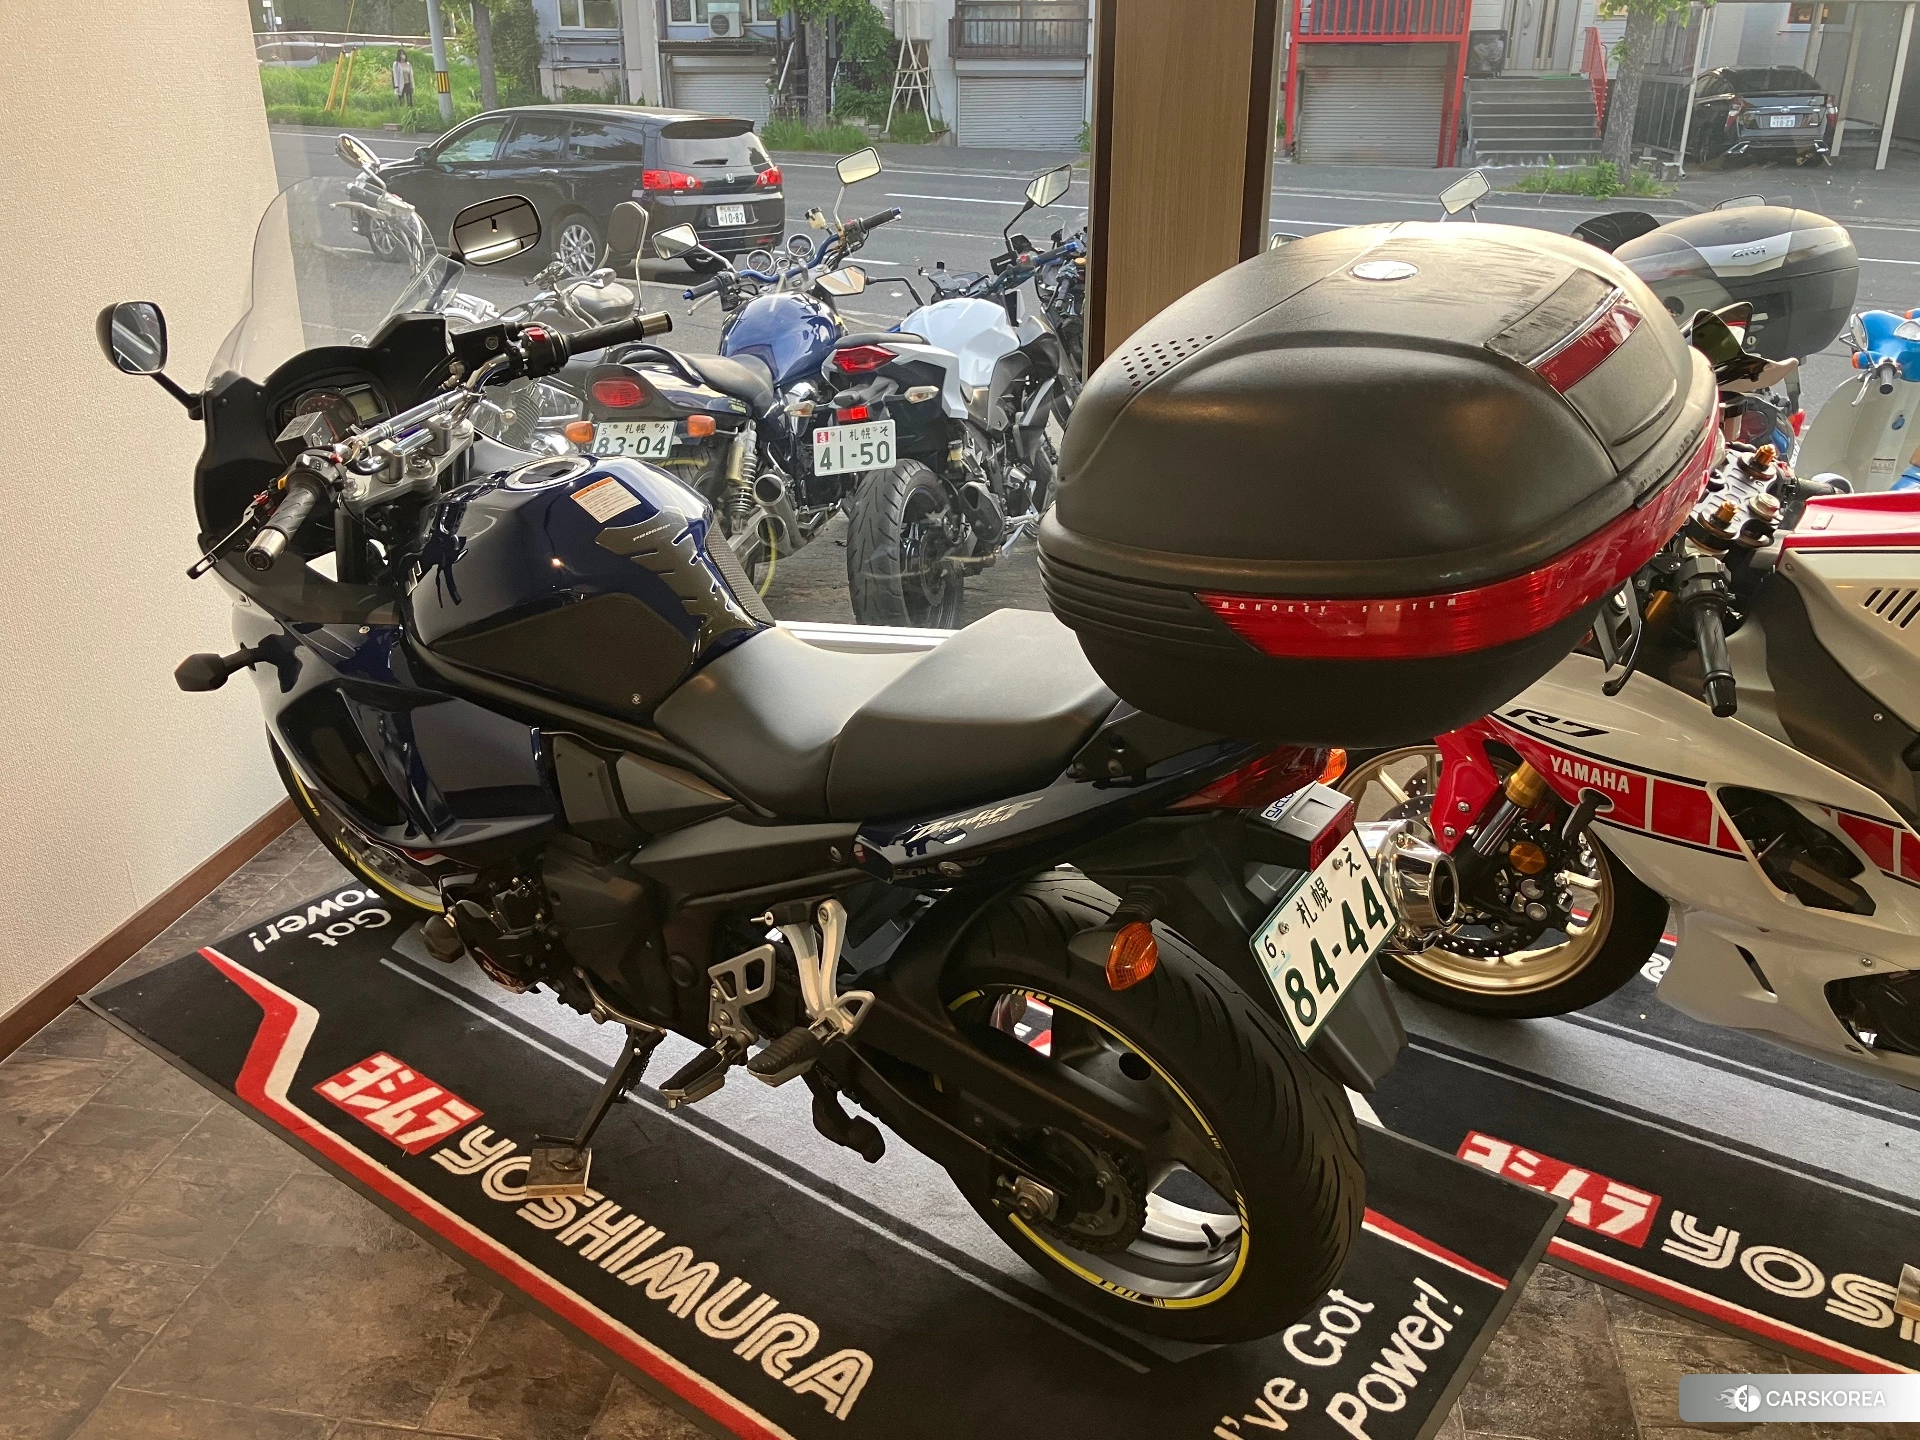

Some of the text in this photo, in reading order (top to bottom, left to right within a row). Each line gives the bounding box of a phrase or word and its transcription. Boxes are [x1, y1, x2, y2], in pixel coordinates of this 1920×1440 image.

[724, 212, 745, 224] 10-82
[1732, 245, 1766, 259] GIVI
[625, 423, 647, 434] 札幌
[659, 423, 669, 434] か
[849, 427, 872, 441] 札幌
[879, 425, 888, 437] そ
[596, 435, 667, 455] 83-04
[819, 440, 890, 470] 41-50
[1221, 598, 1457, 613] MONOKEY SYSTEM
[1504, 708, 1610, 738] R7
[1549, 753, 1630, 795] YAMAHA
[974, 813, 1013, 830] 1250
[1295, 876, 1333, 929] 札幌
[1341, 846, 1362, 878] え
[308, 908, 392, 947] Got
[1264, 934, 1277, 959] 6
[1284, 875, 1389, 1027] 84-44
[320, 1054, 478, 1145] ヨシムラ
[430, 1125, 874, 1421] YOSHIMURA
[1283, 1288, 1375, 1367] Got
[1325, 1277, 1464, 1440] Power!
